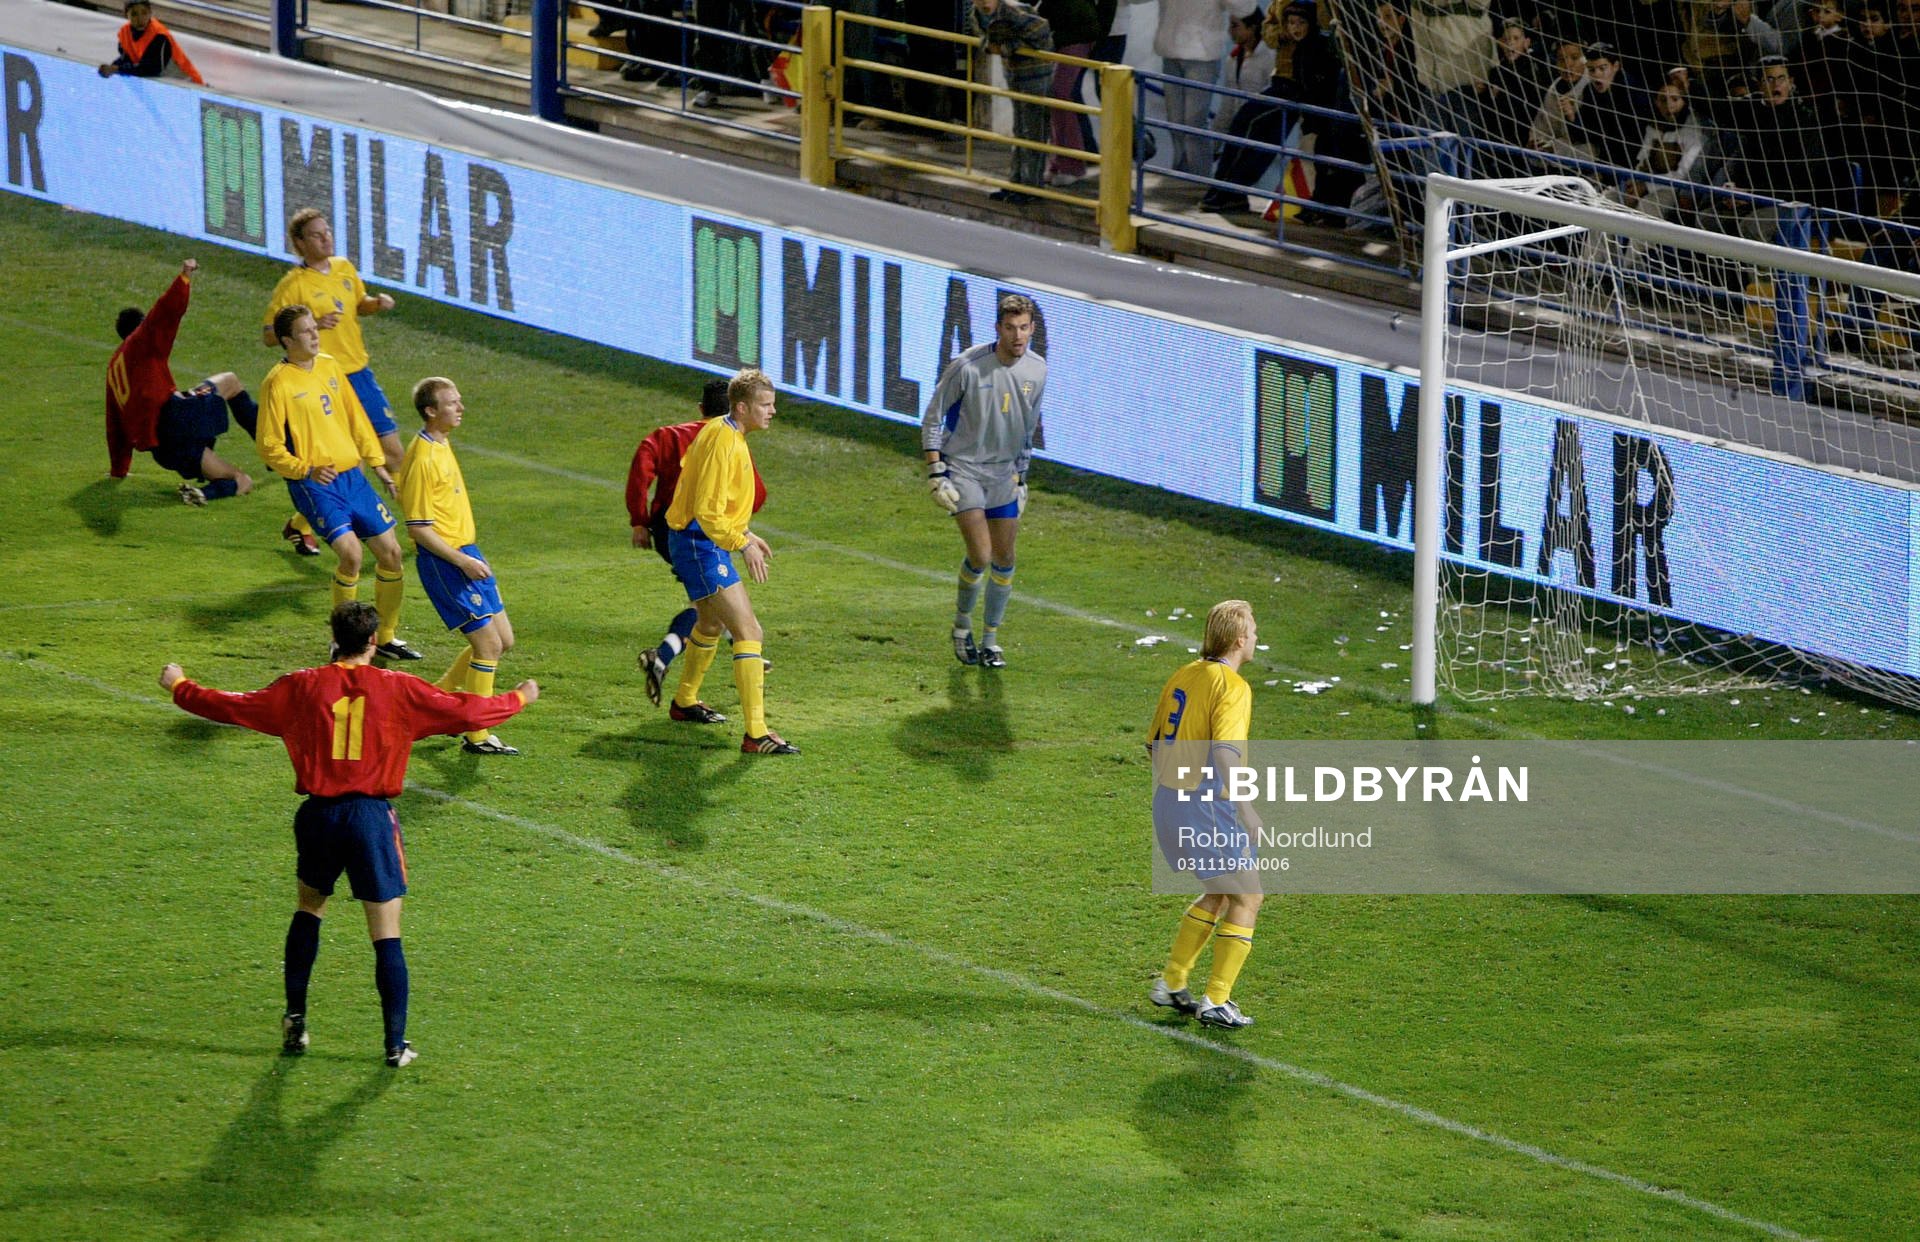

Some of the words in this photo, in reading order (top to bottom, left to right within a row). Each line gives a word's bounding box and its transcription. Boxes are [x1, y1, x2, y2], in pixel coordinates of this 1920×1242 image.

[280, 117, 515, 312] MILAR
[320, 394, 332, 415] 2
[376, 502, 393, 524] 2
[1359, 372, 1675, 608] MILAR
[331, 695, 365, 760] 11
[1164, 687, 1187, 745] 3
